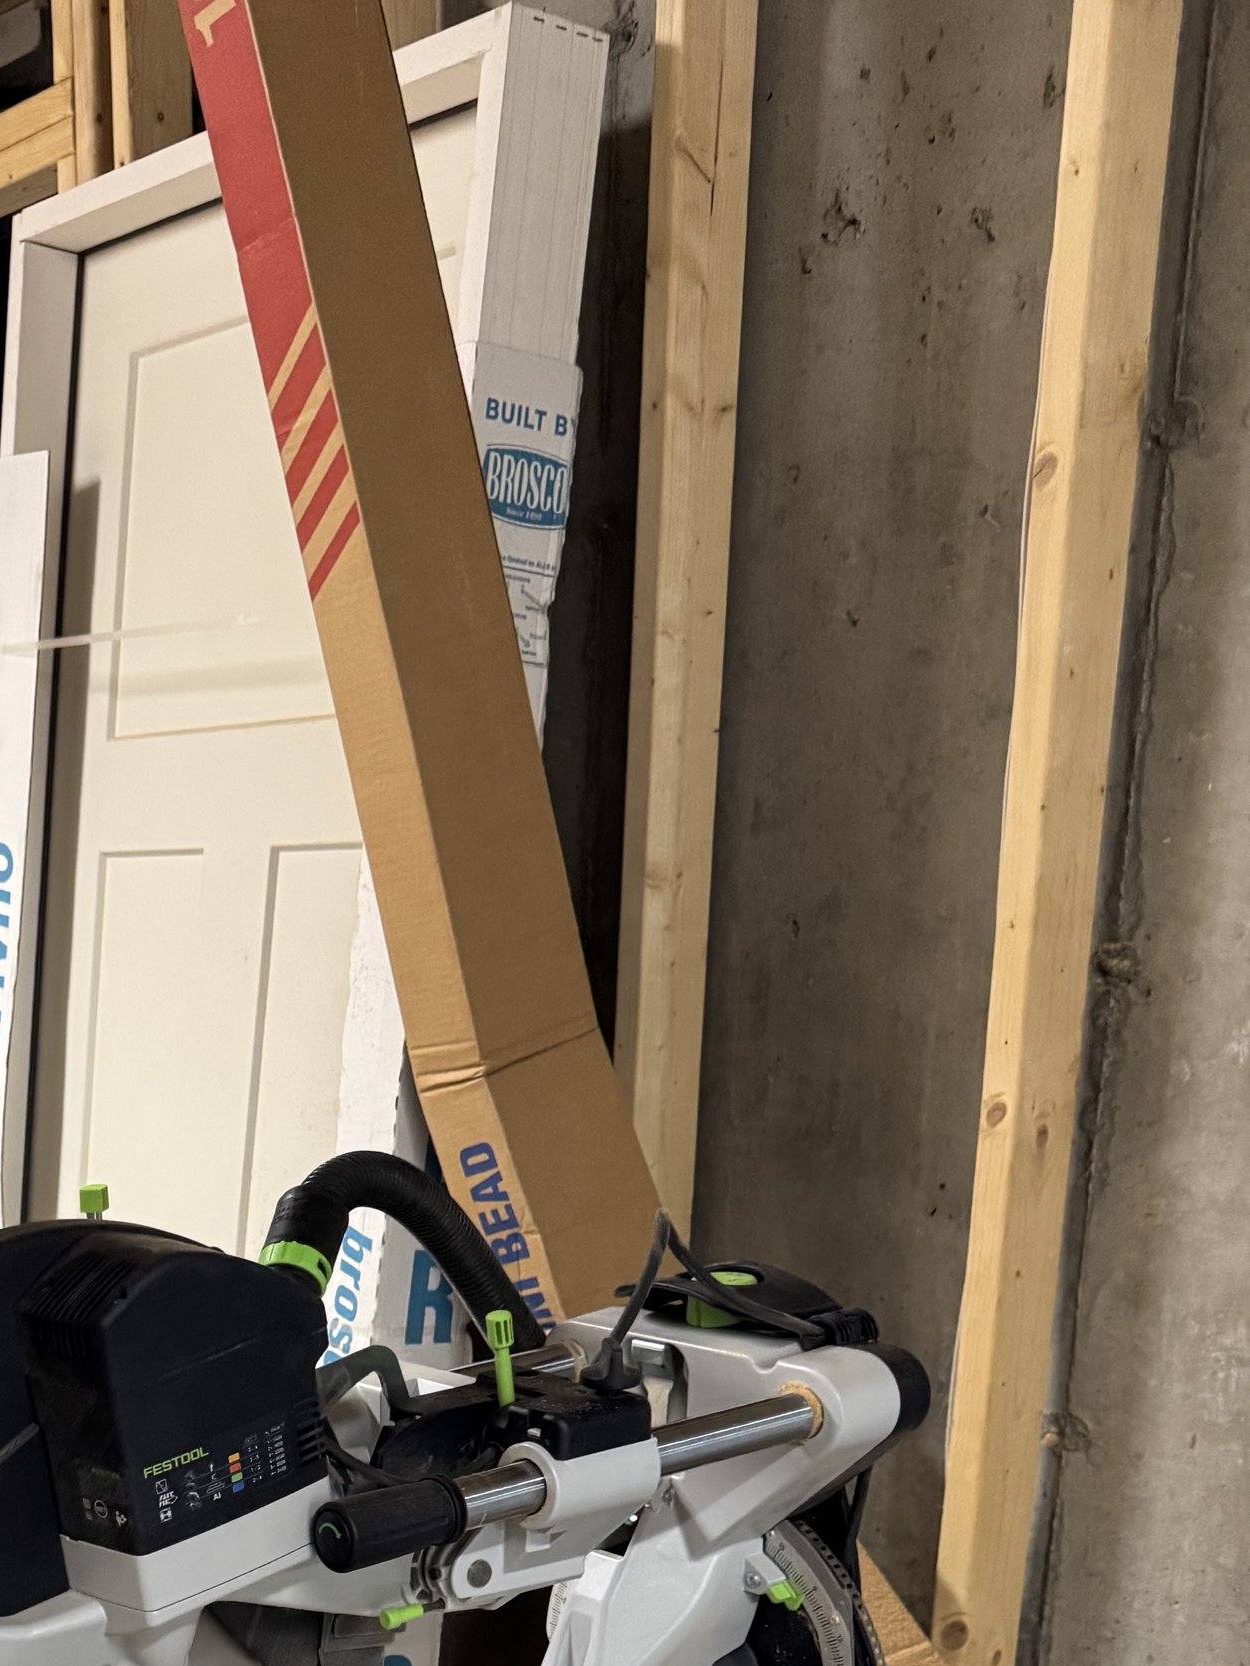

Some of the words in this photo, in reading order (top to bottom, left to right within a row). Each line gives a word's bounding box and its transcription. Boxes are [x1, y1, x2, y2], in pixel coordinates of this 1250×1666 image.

[485, 397, 548, 432] BUILT
[486, 450, 568, 514] BROSCO
[459, 1142, 531, 1265] BEAD
[142, 1446, 211, 1480] FESTOOL
